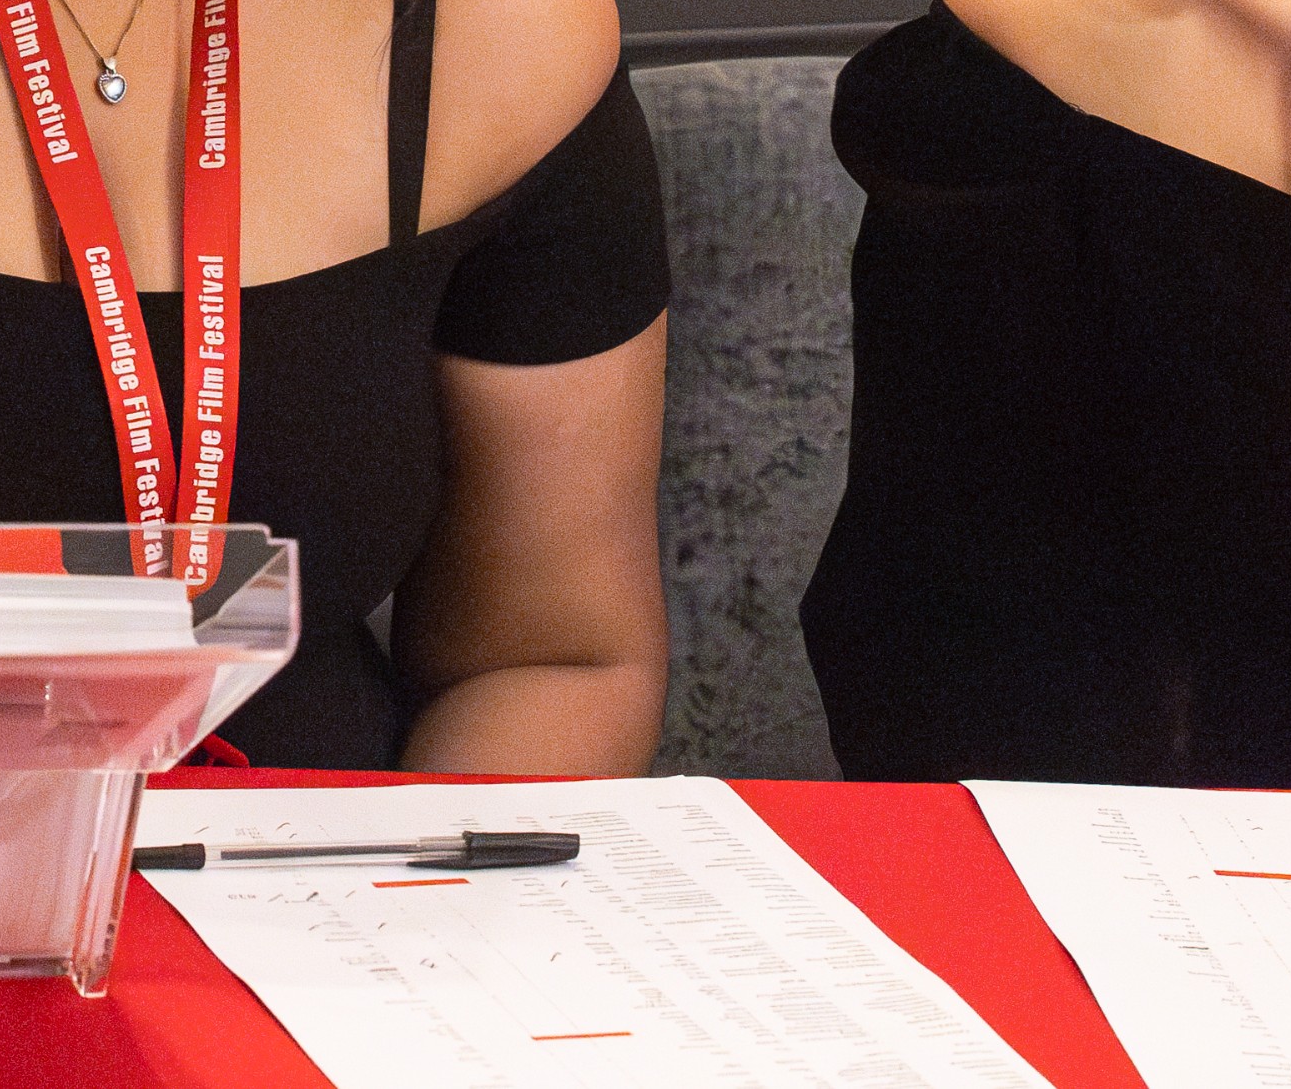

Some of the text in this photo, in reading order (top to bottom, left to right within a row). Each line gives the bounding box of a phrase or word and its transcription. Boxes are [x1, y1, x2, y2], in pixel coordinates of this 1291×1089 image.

[6, 1, 39, 58] Film
[23, 57, 78, 164] Festival
[199, 32, 230, 169] Cambridge
[85, 246, 169, 577] Cambridge Film Festival
[184, 255, 225, 587] Cambridge Film Festival
